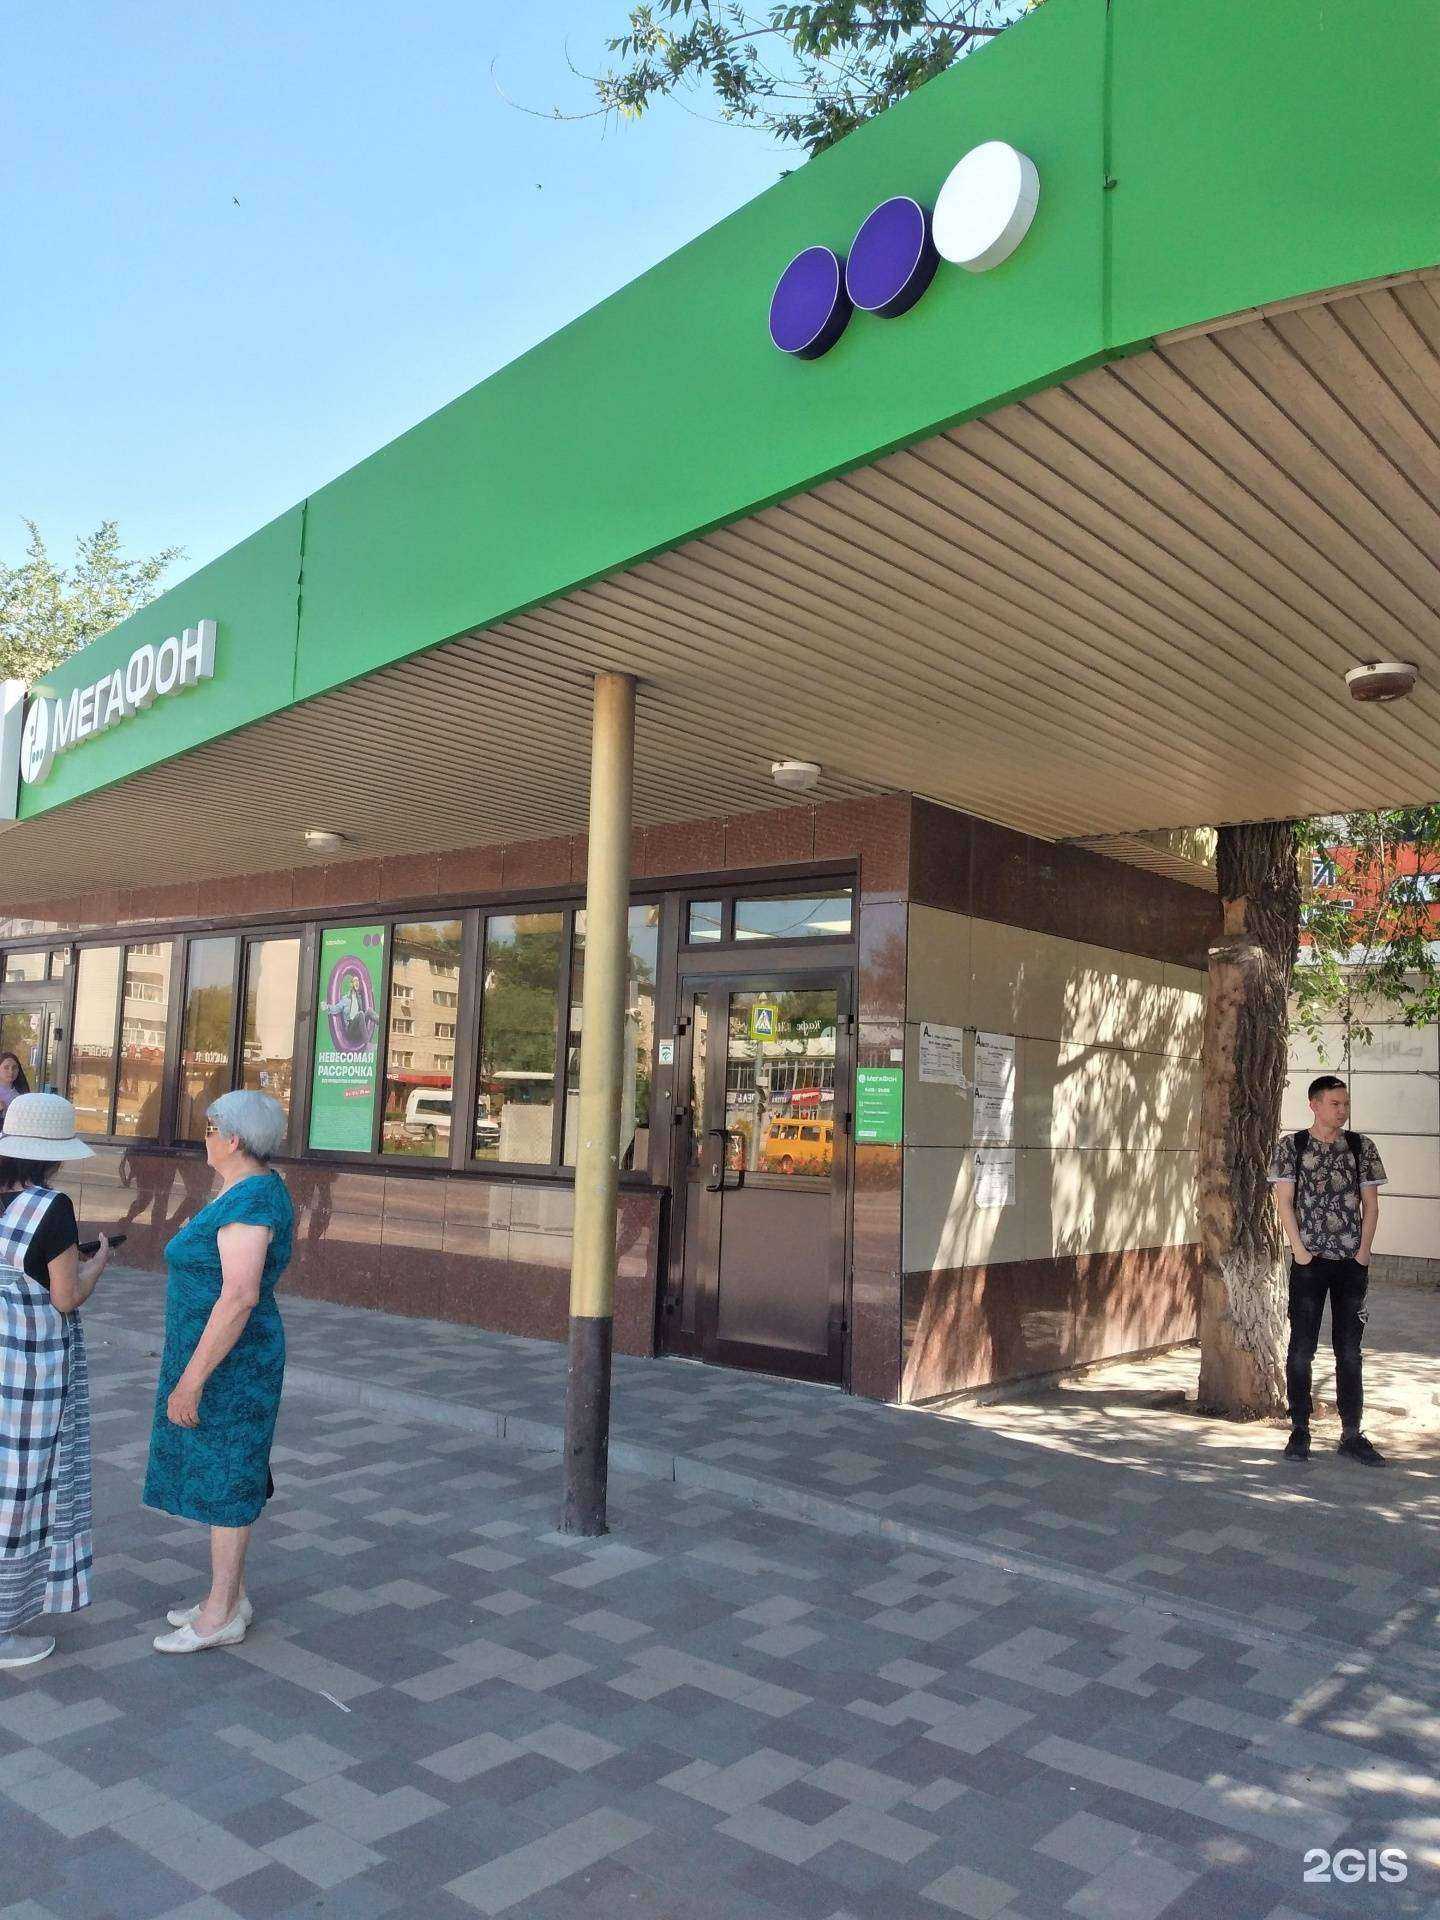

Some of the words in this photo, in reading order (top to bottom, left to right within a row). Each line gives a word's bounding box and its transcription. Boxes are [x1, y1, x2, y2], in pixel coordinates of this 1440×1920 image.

[52, 619, 217, 752] МЕГАФОН
[318, 1051, 374, 1063] НЕВЕСОМАЯ
[317, 1065, 373, 1078] РАССРОЧКА
